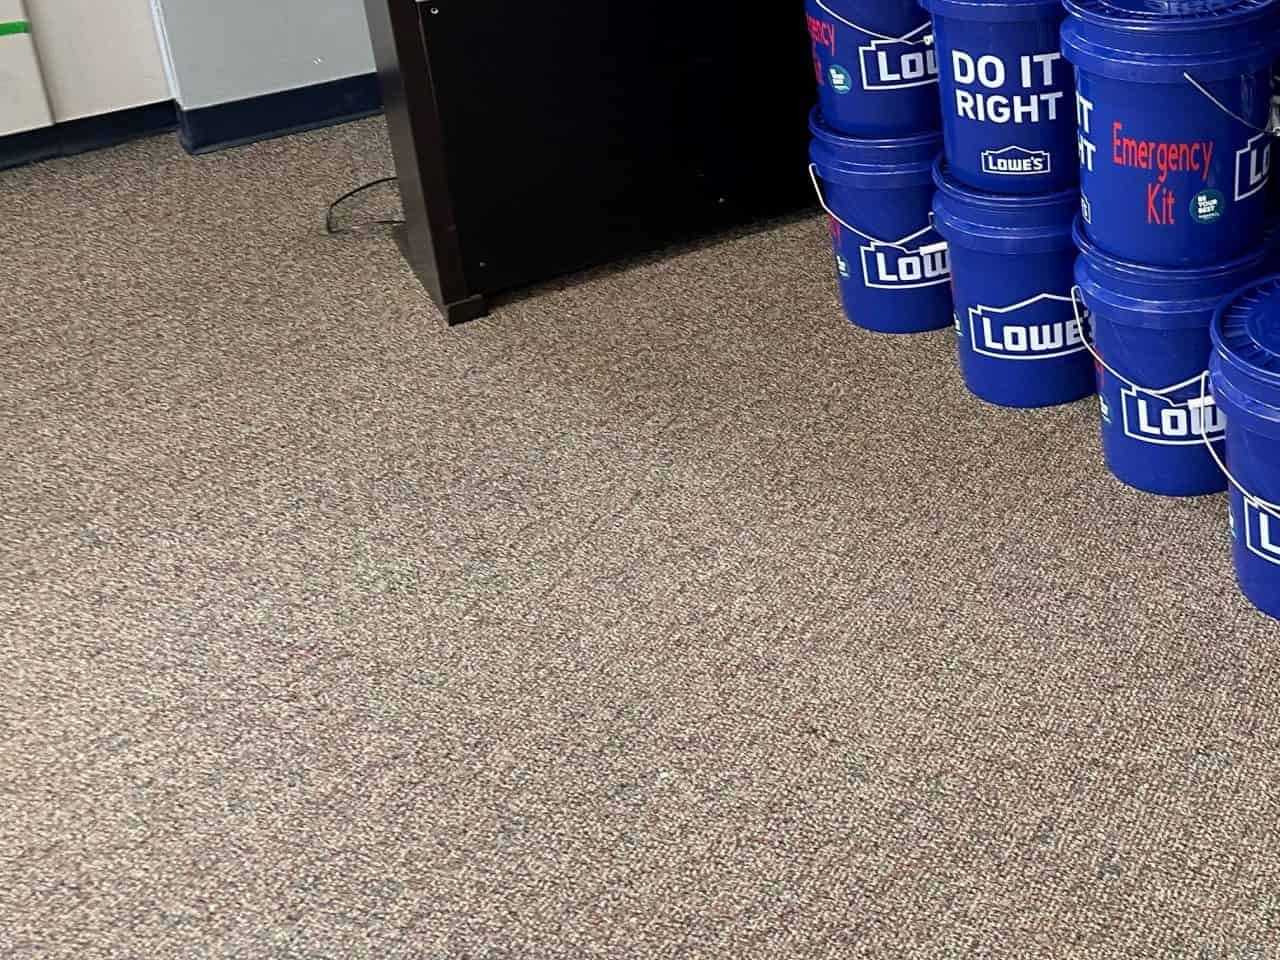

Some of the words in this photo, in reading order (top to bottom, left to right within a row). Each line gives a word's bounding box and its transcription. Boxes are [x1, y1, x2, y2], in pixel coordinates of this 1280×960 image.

[952, 49, 1006, 89] DO
[1020, 52, 1061, 88] IT
[955, 89, 1064, 123] RIGHT
[987, 153, 1045, 171] LOWE'S
[1112, 121, 1214, 181] Emergency
[1146, 183, 1176, 225] Kit
